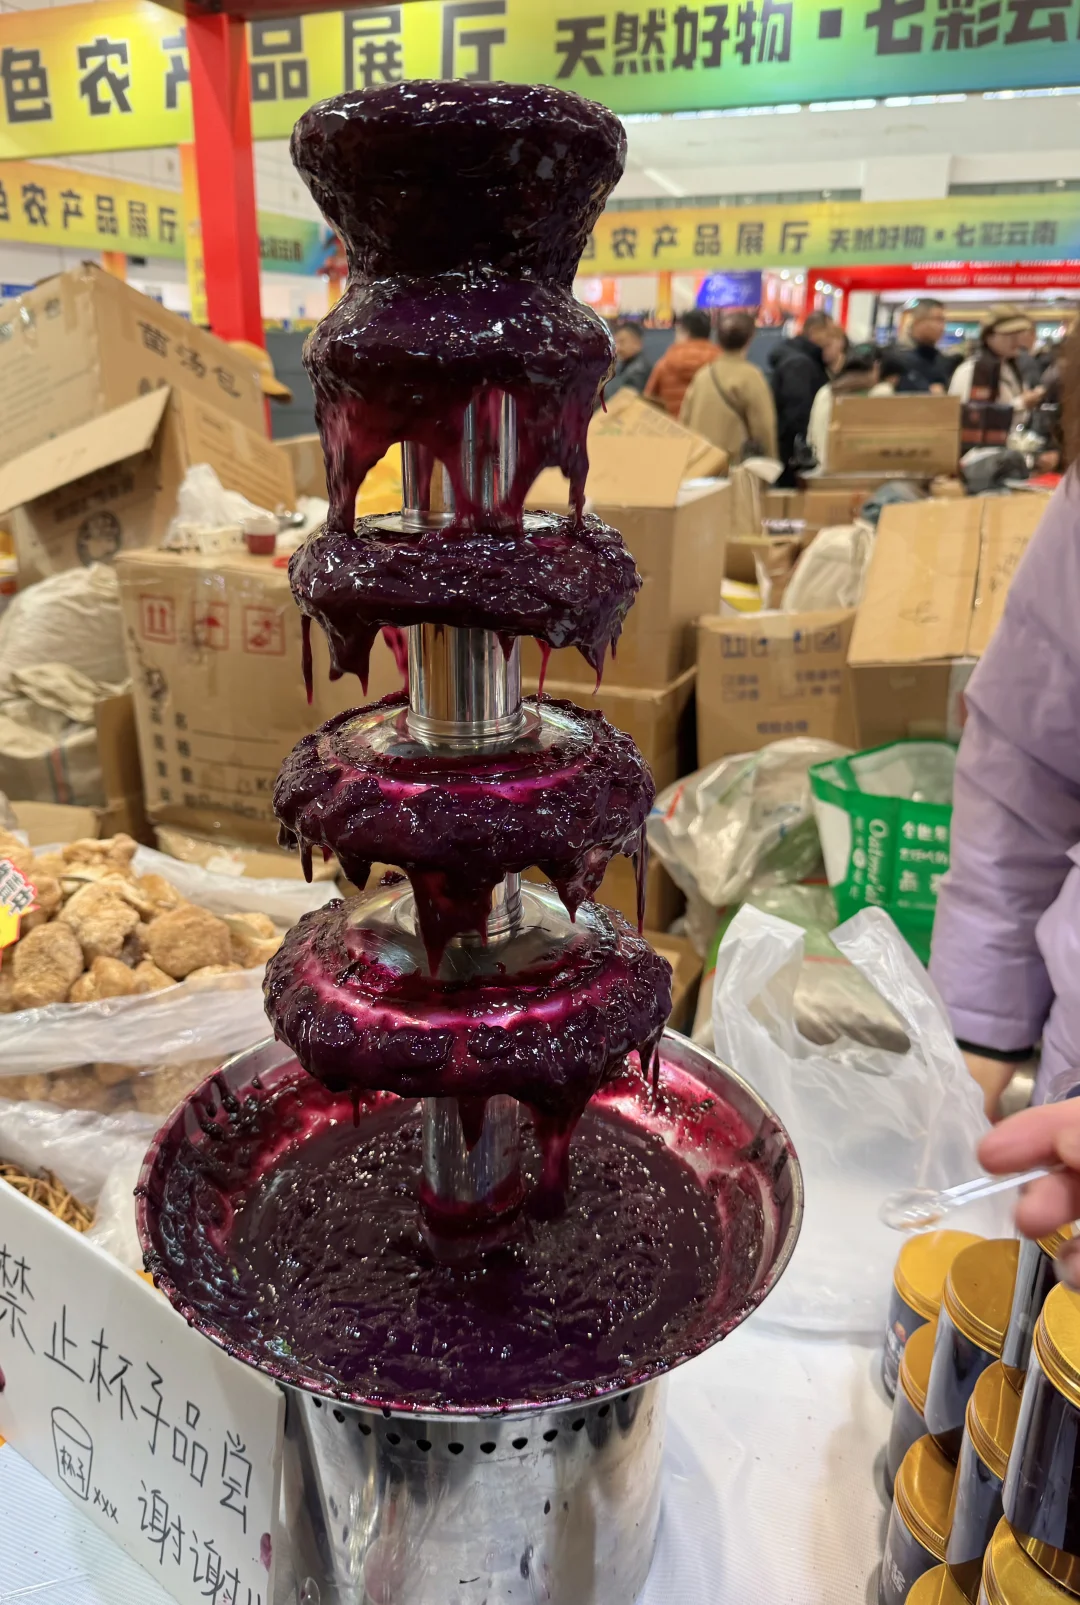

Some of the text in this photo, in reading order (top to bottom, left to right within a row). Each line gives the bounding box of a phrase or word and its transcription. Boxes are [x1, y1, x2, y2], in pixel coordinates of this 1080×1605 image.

[556, 0, 1080, 79] 天然好物·七彩云
[60, 1445, 86, 1492] 杯子
